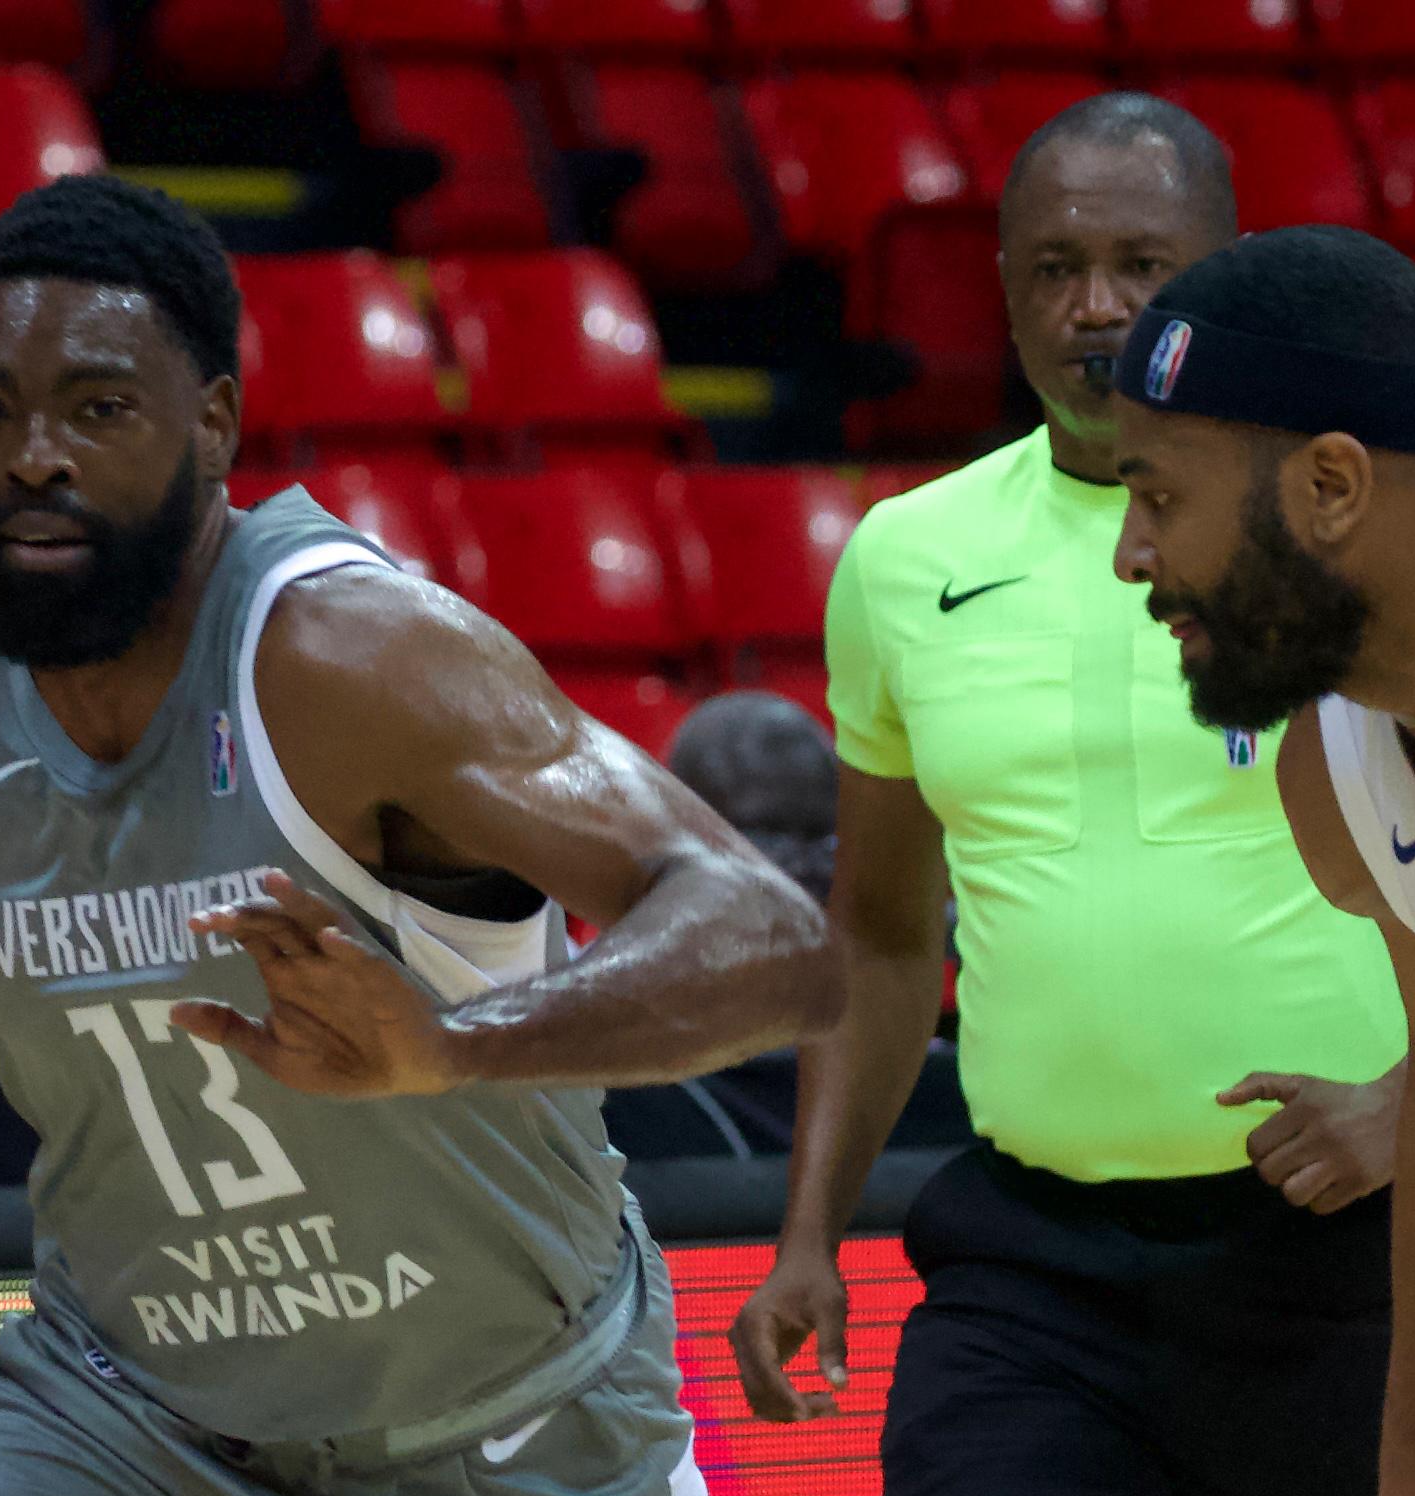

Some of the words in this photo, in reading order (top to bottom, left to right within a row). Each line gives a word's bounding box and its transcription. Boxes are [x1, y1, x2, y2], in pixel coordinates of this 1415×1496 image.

[65, 997, 306, 1218] 13
[159, 1214, 336, 1282] VISIT
[130, 1250, 436, 1346] RWANDA
